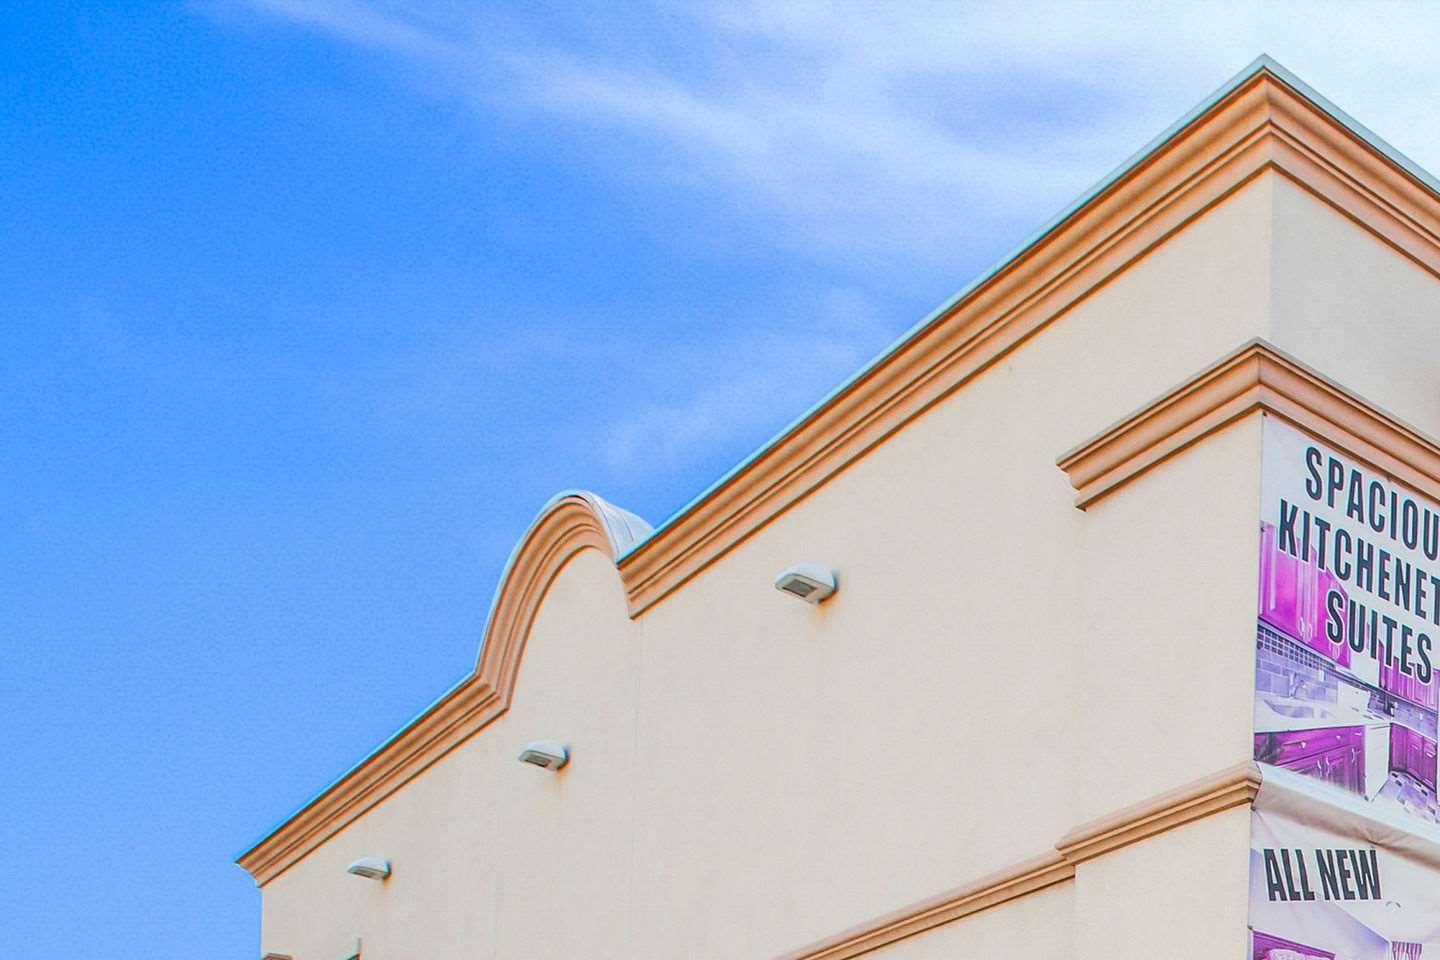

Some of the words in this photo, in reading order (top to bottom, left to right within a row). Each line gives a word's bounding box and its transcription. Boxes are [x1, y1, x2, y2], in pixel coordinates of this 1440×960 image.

[1326, 590, 1432, 684] SUITES
[1263, 848, 1315, 901] ALL
[1315, 849, 1382, 901] NEW
